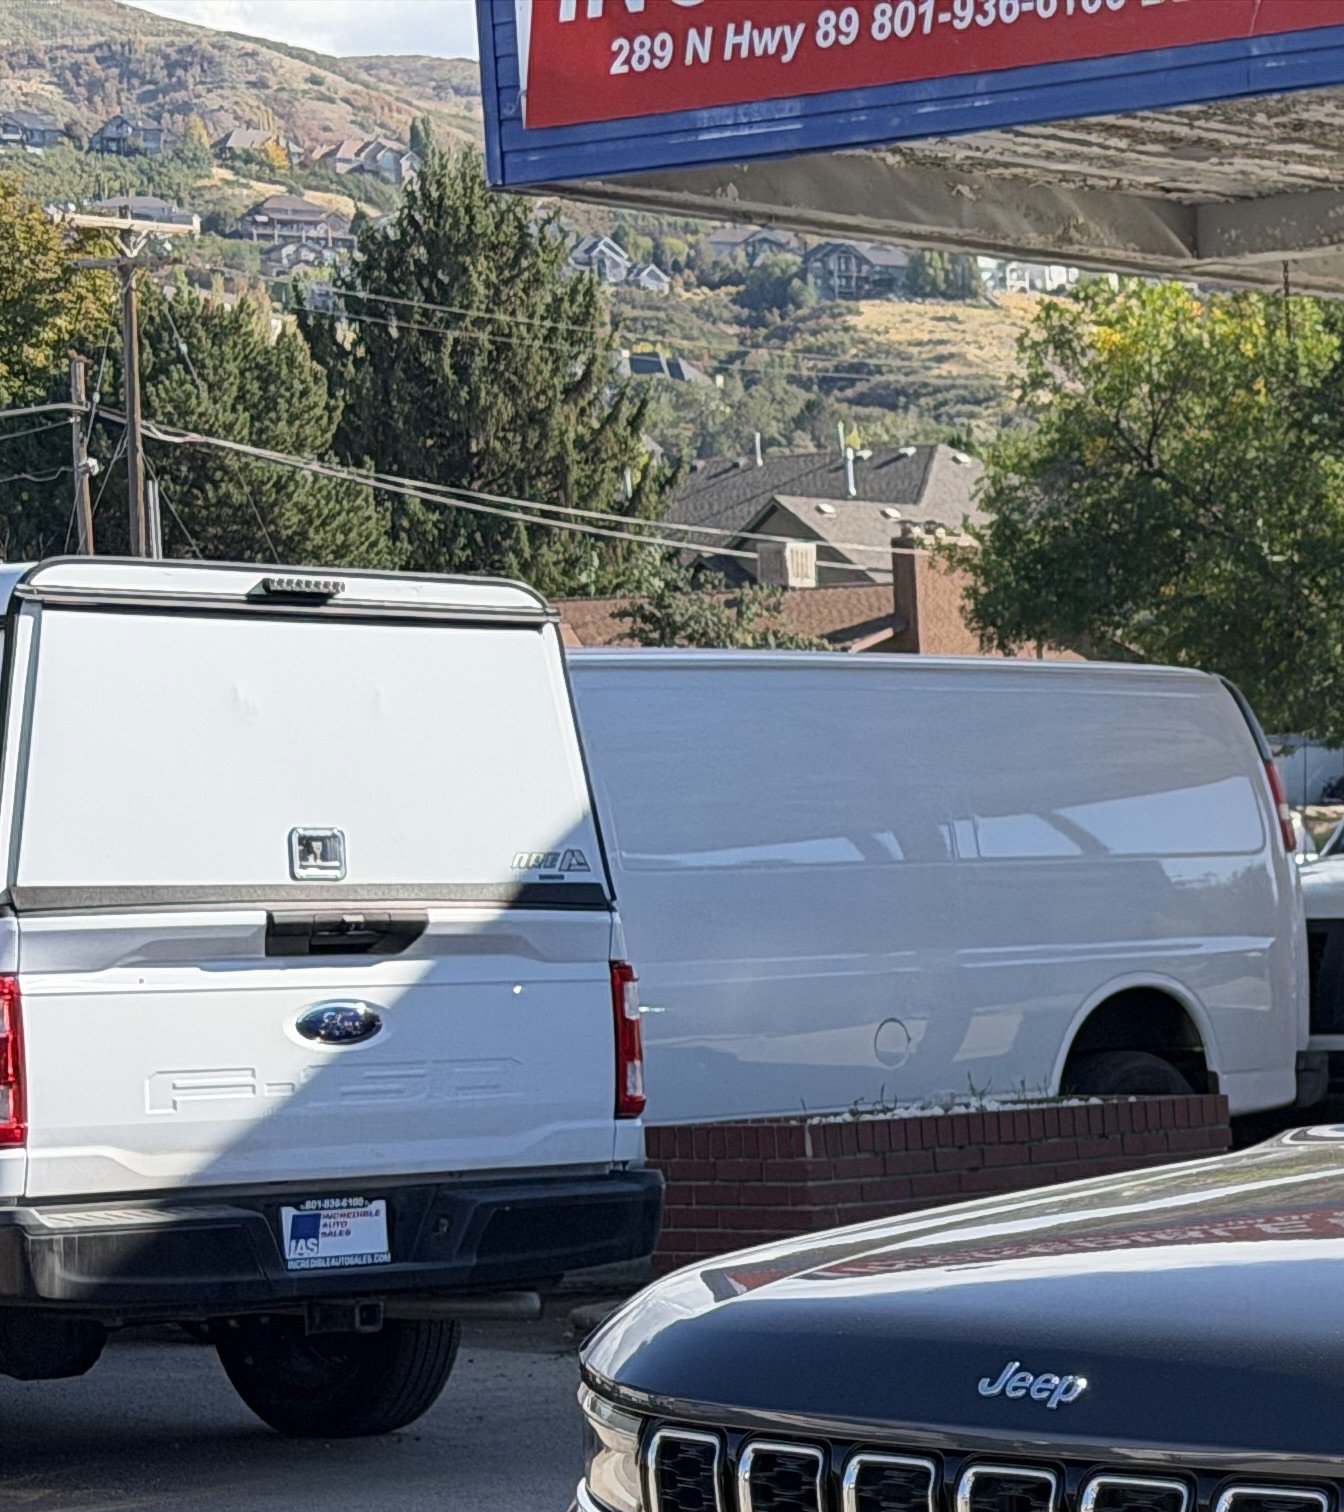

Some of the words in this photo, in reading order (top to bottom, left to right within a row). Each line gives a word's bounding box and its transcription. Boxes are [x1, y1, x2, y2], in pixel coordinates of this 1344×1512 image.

[610, 32, 673, 75] 289
[685, 26, 712, 65] N
[724, 20, 805, 63] Hwy
[815, 9, 858, 48] 89
[322, 1221, 348, 1229] AUTO
[289, 1238, 319, 1257] IAS
[978, 1361, 1087, 1410] Jeep
